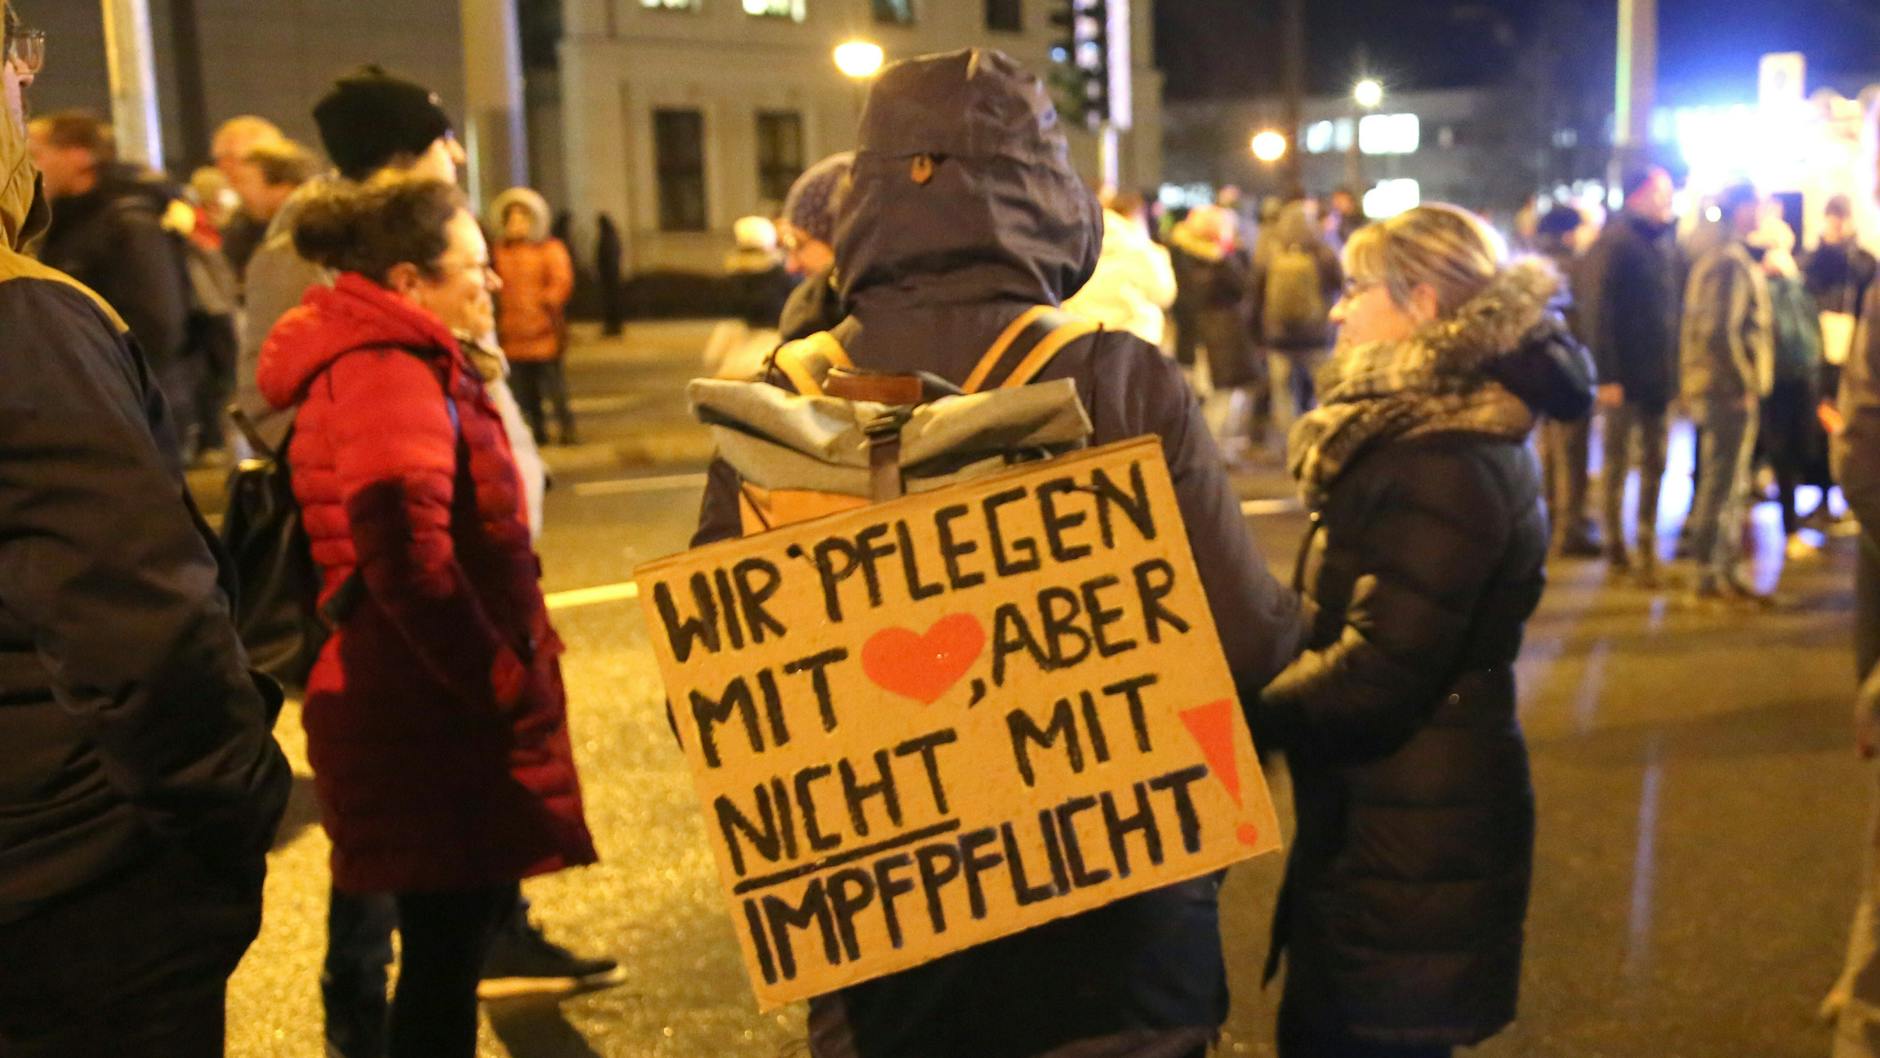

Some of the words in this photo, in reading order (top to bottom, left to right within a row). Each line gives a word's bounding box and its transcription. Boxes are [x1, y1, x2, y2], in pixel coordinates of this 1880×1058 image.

[653, 557, 786, 663] WIR
[812, 460, 1158, 623] PFLEGEN
[688, 647, 848, 769] MIT
[713, 727, 958, 877] NICHT
[1006, 673, 1159, 788] MIT
